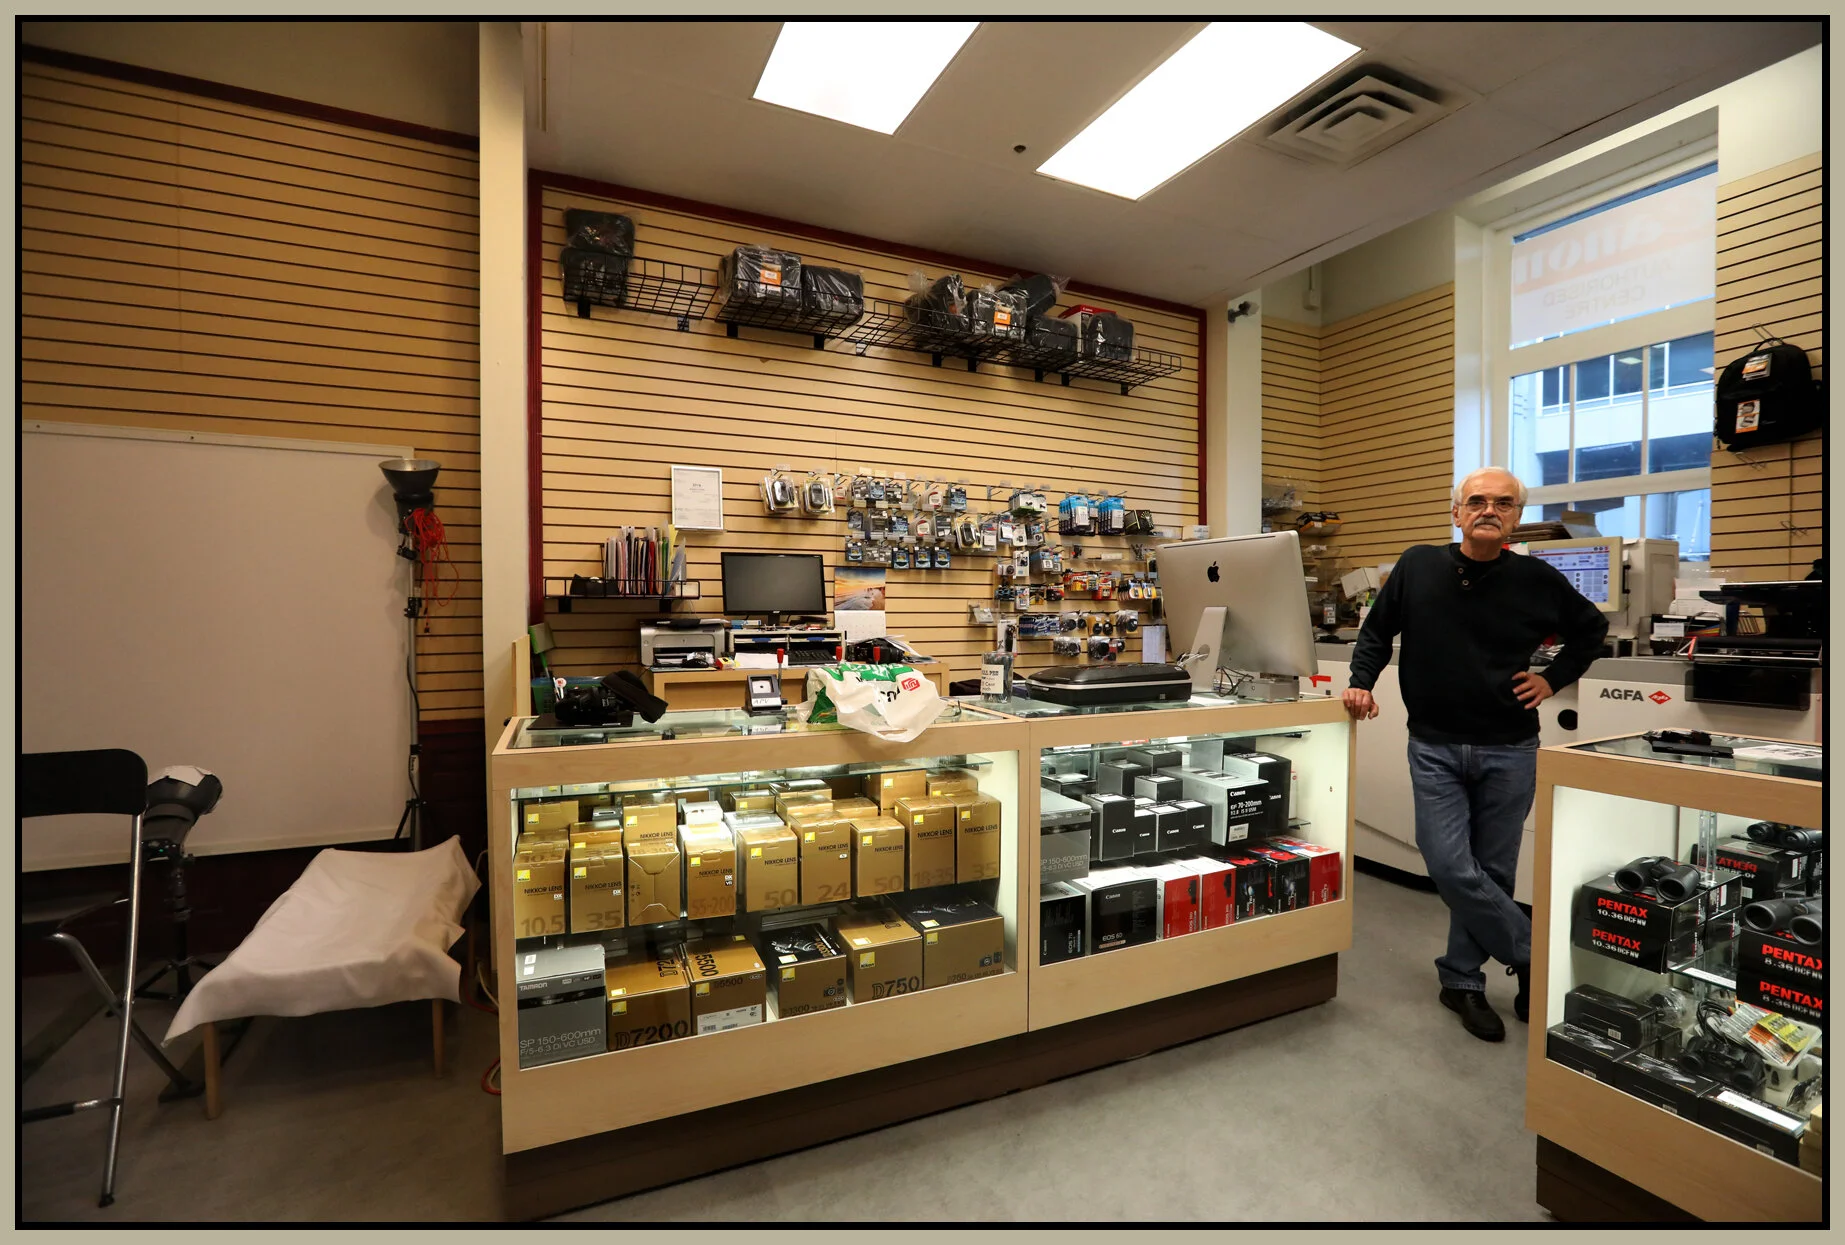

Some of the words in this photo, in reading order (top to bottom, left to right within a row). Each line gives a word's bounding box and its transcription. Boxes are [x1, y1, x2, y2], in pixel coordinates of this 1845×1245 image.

[1600, 688, 1644, 701] AGFA
[918, 830, 940, 838] NIKKOR
[940, 828, 952, 836] LENS
[964, 826, 985, 834] NIKKOR
[764, 858, 784, 866] NIKKOR
[1049, 854, 1088, 865] 150-600mm
[972, 861, 998, 880] 35
[524, 886, 547, 894] NIKKOR
[818, 882, 849, 902] 24
[874, 876, 903, 891] 50
[692, 895, 735, 914] 55-200
[764, 889, 795, 909] 50
[1597, 897, 1649, 919] PENTAX
[520, 914, 565, 936] 10.5
[586, 910, 621, 931] 35
[1102, 934, 1116, 942] EOS
[1592, 927, 1641, 951] PENTAX
[1762, 944, 1822, 971] PENTAX
[520, 982, 548, 992] TAMRON
[872, 976, 920, 1000] D750
[1760, 981, 1822, 1010] PENTAX
[520, 1038, 535, 1049] SP
[538, 1028, 601, 1046] 150-600mm
[615, 1020, 689, 1050] D7200
[520, 1044, 552, 1056] F/5-6.3
[562, 1040, 576, 1048] VC
[577, 1036, 596, 1046] USD
